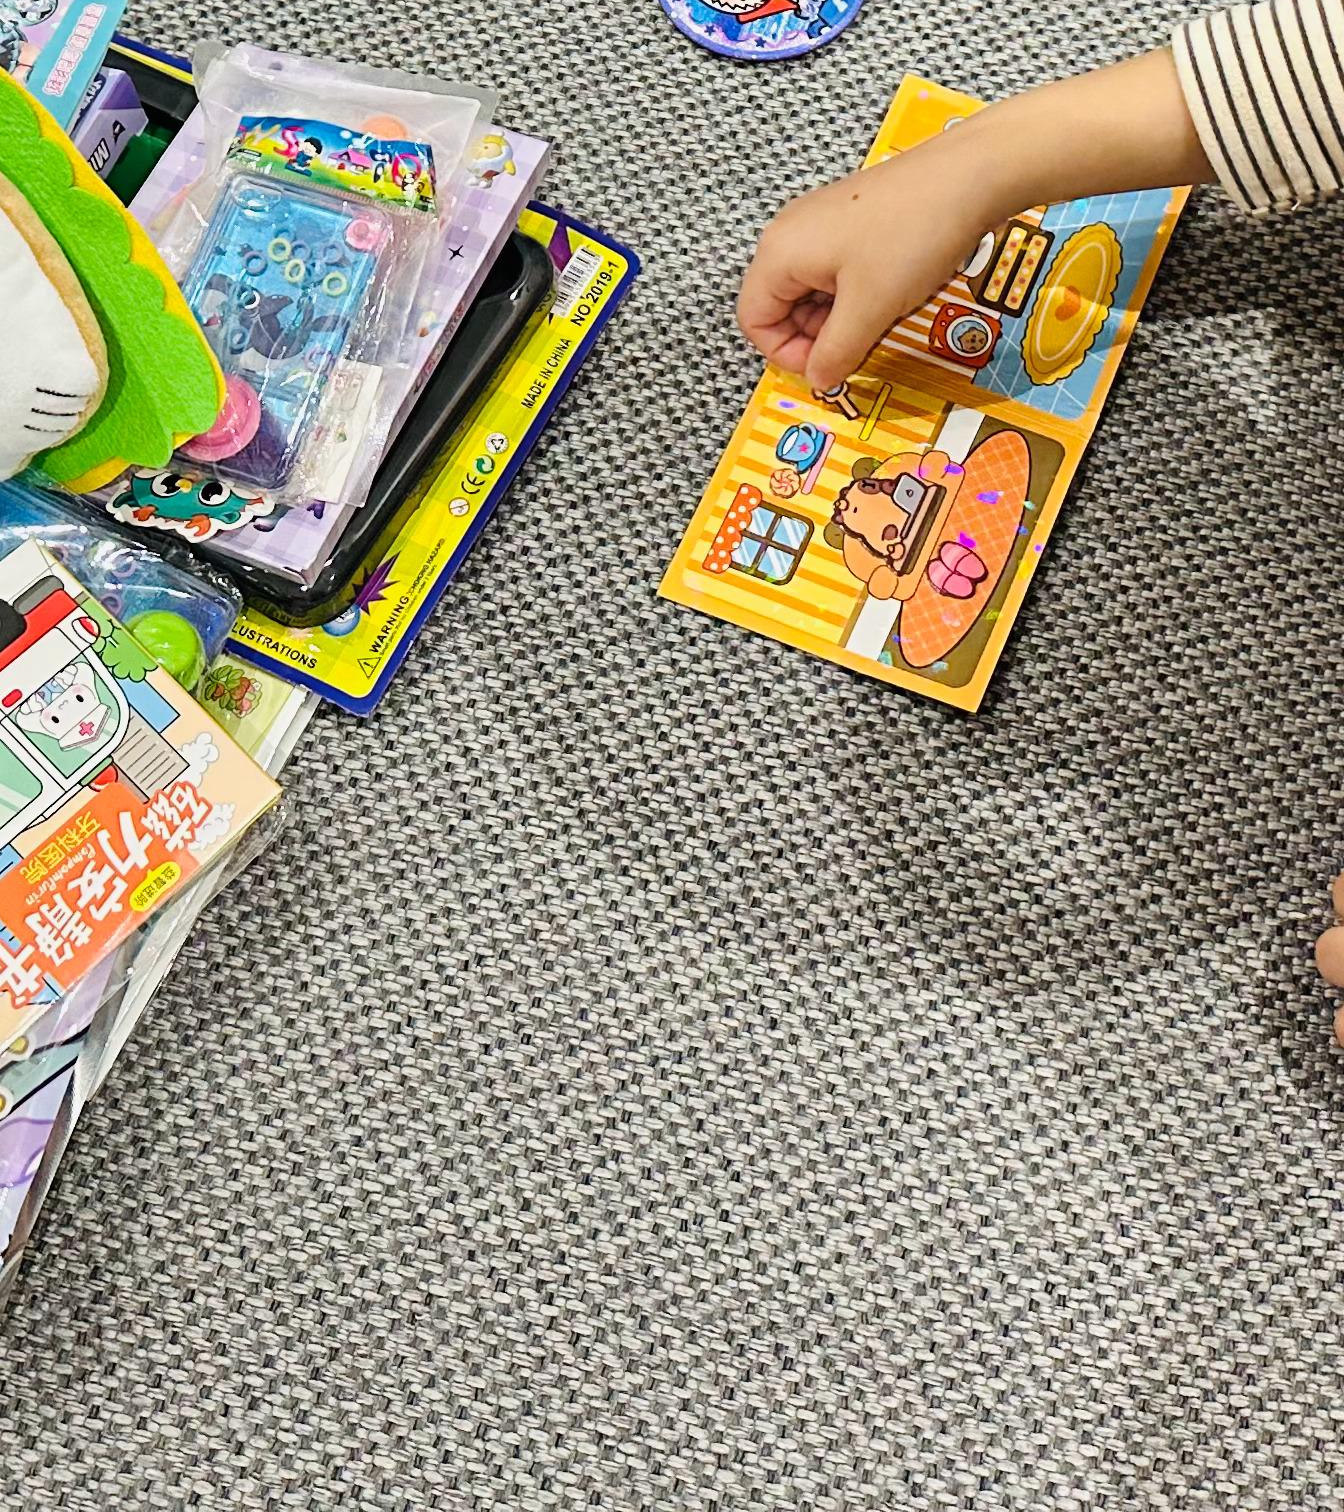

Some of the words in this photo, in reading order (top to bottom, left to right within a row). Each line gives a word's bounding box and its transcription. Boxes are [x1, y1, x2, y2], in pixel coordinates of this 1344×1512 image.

[522, 381, 549, 409] MADE
[546, 337, 572, 370] CHINA
[369, 595, 408, 654] WARNING
[18, 809, 101, 887] 牙科医院
[136, 866, 177, 907] 益智进阶
